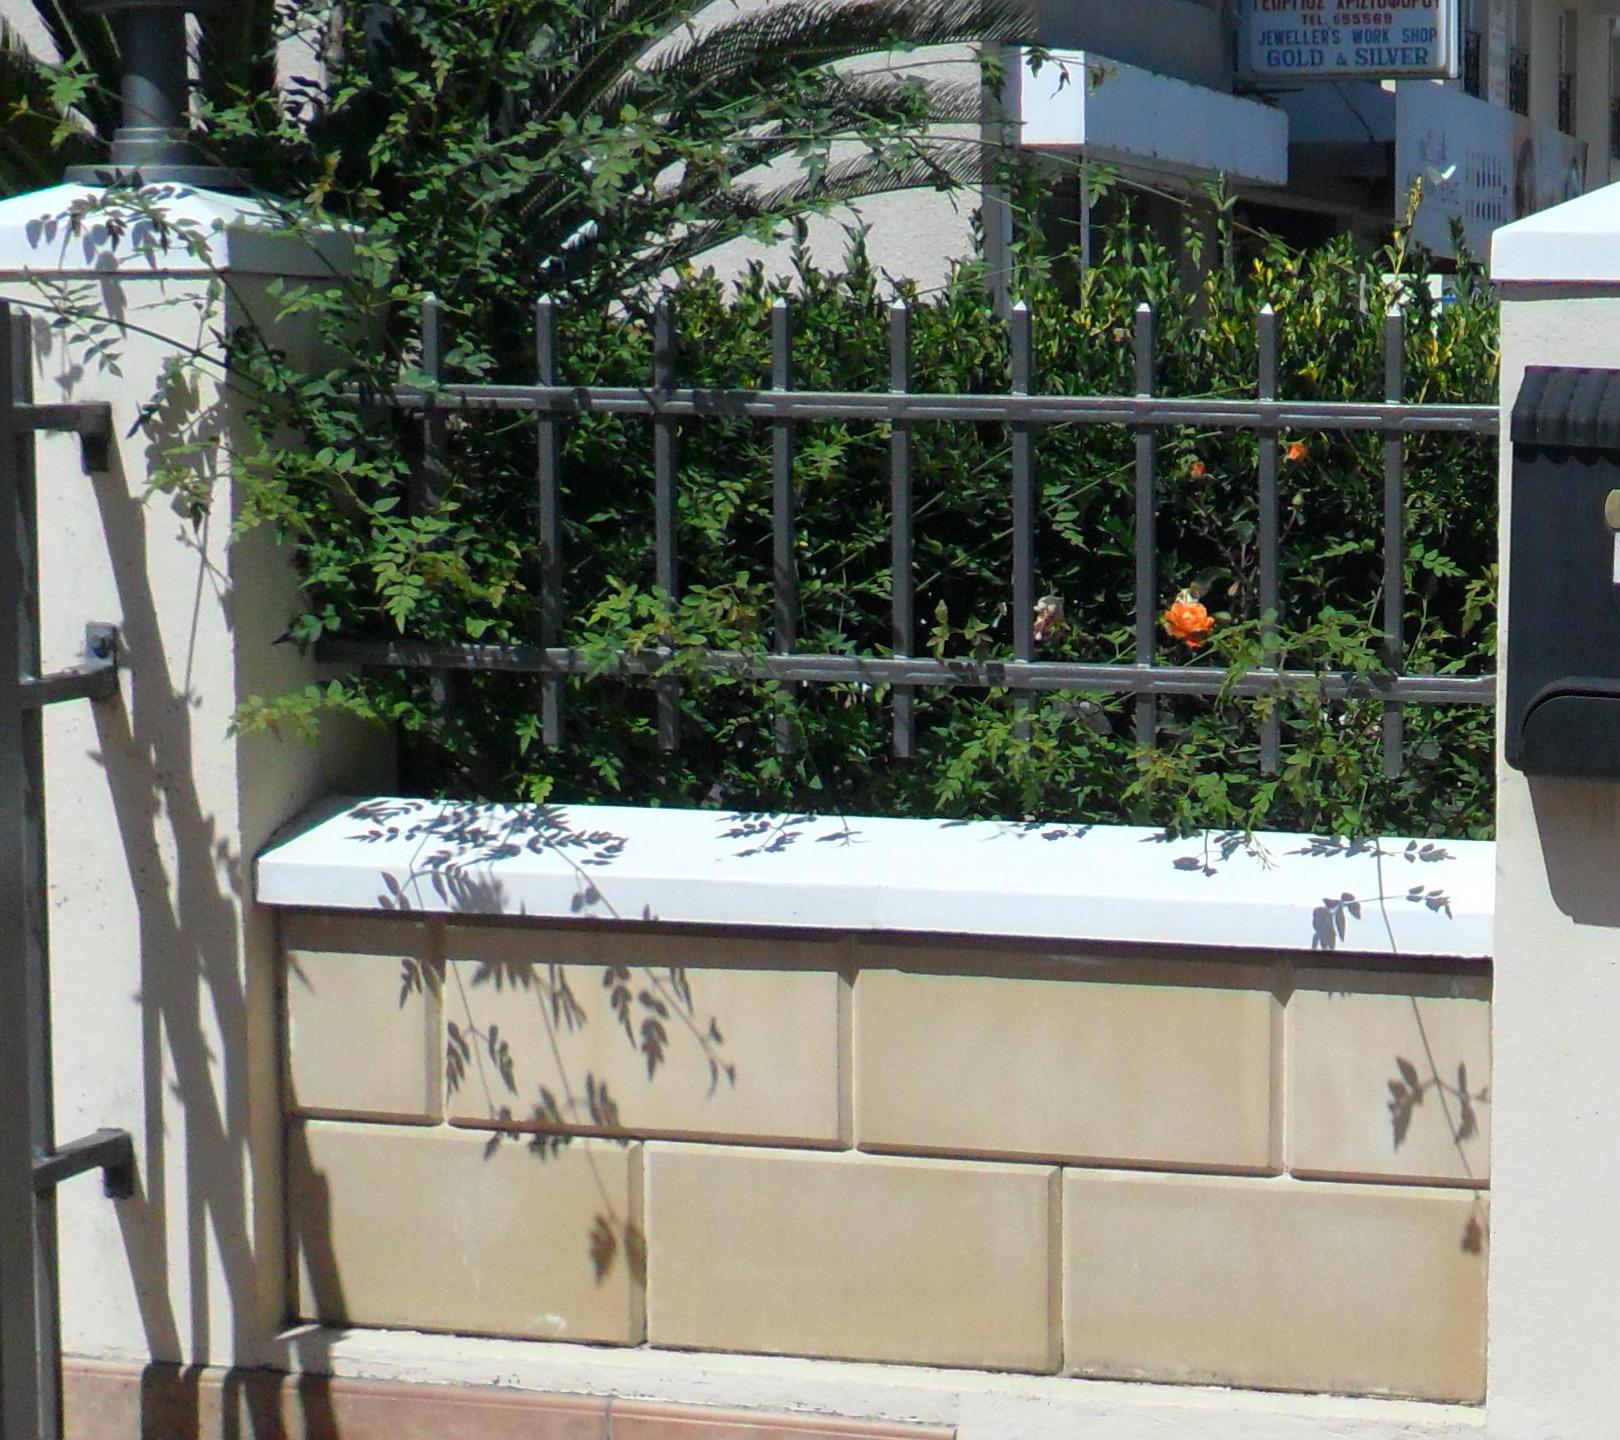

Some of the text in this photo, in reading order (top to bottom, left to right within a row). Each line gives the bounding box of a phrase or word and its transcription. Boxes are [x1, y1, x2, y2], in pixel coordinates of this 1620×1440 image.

[1352, 29, 1390, 44] WORK
[1402, 28, 1437, 43] SHOP
[1267, 49, 1324, 67] GOLD
[1355, 47, 1428, 66] SILVER
